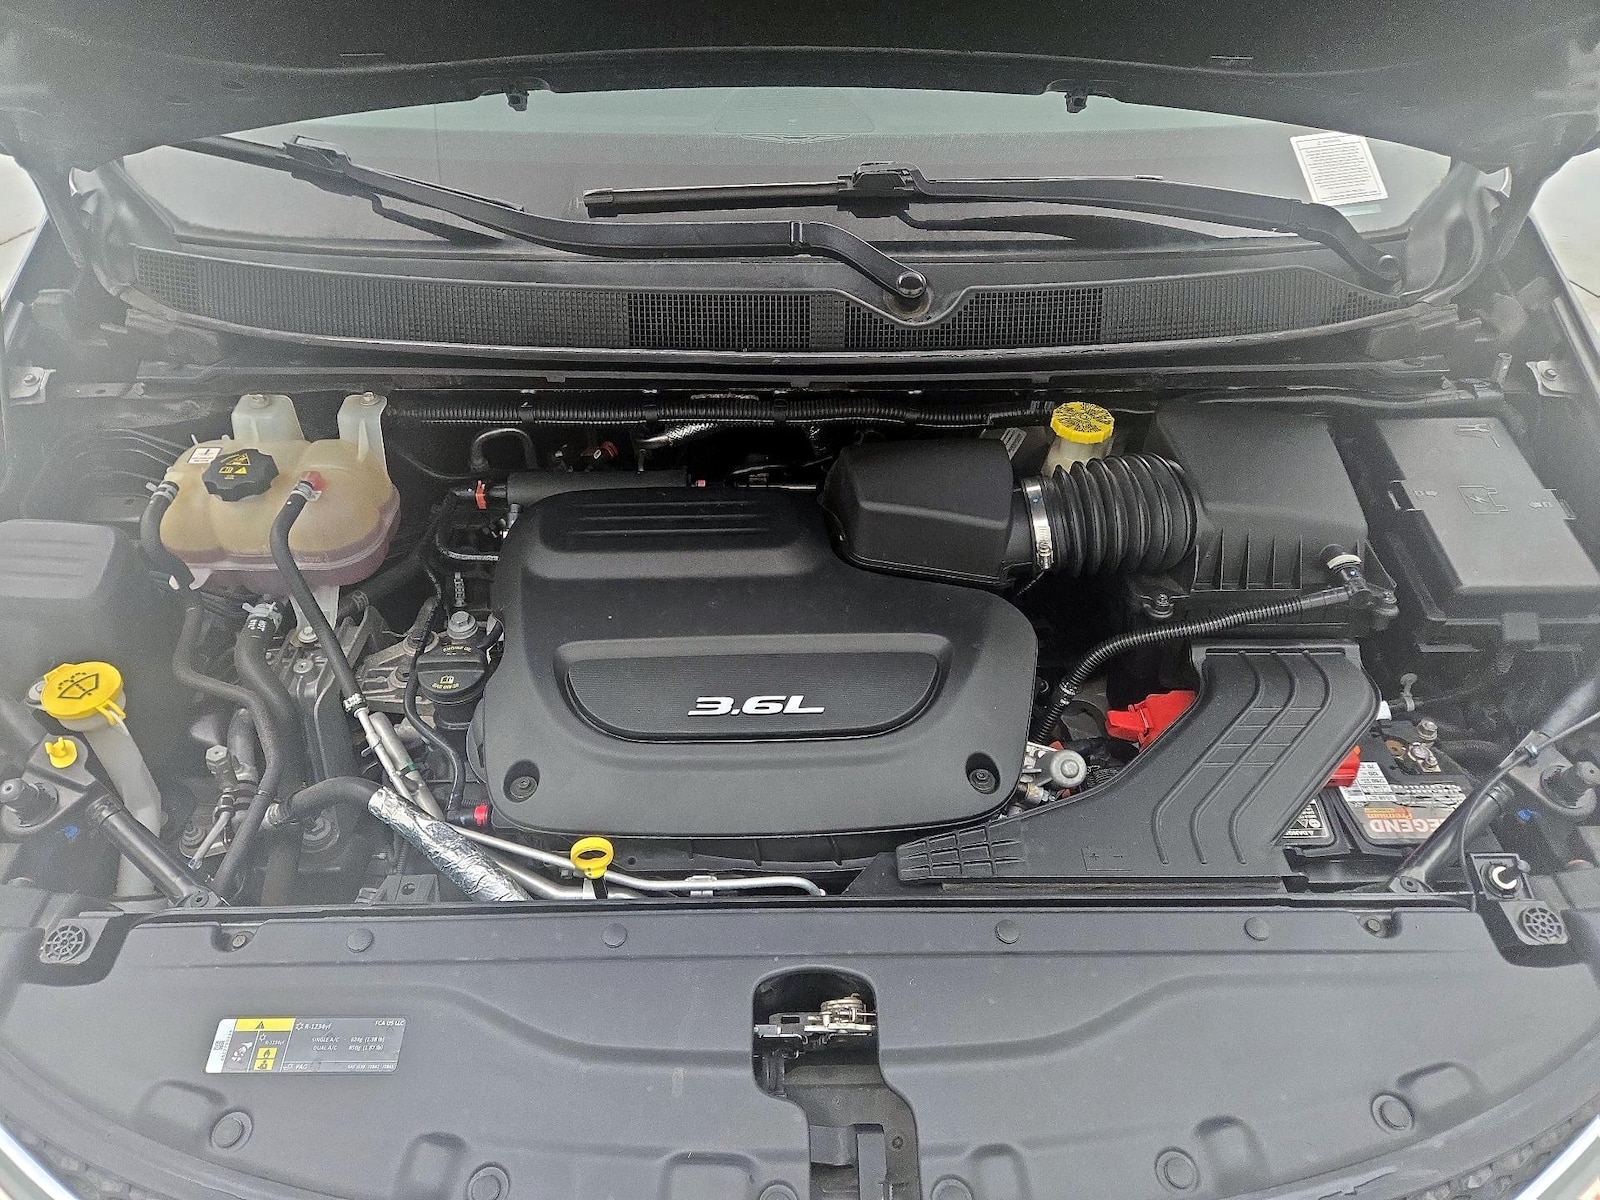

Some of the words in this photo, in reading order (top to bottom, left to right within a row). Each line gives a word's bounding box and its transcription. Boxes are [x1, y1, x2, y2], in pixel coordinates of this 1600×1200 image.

[687, 695, 825, 717] 3.6L
[1369, 818, 1444, 833] EGEND
[304, 1022, 332, 1031] R-1234yf
